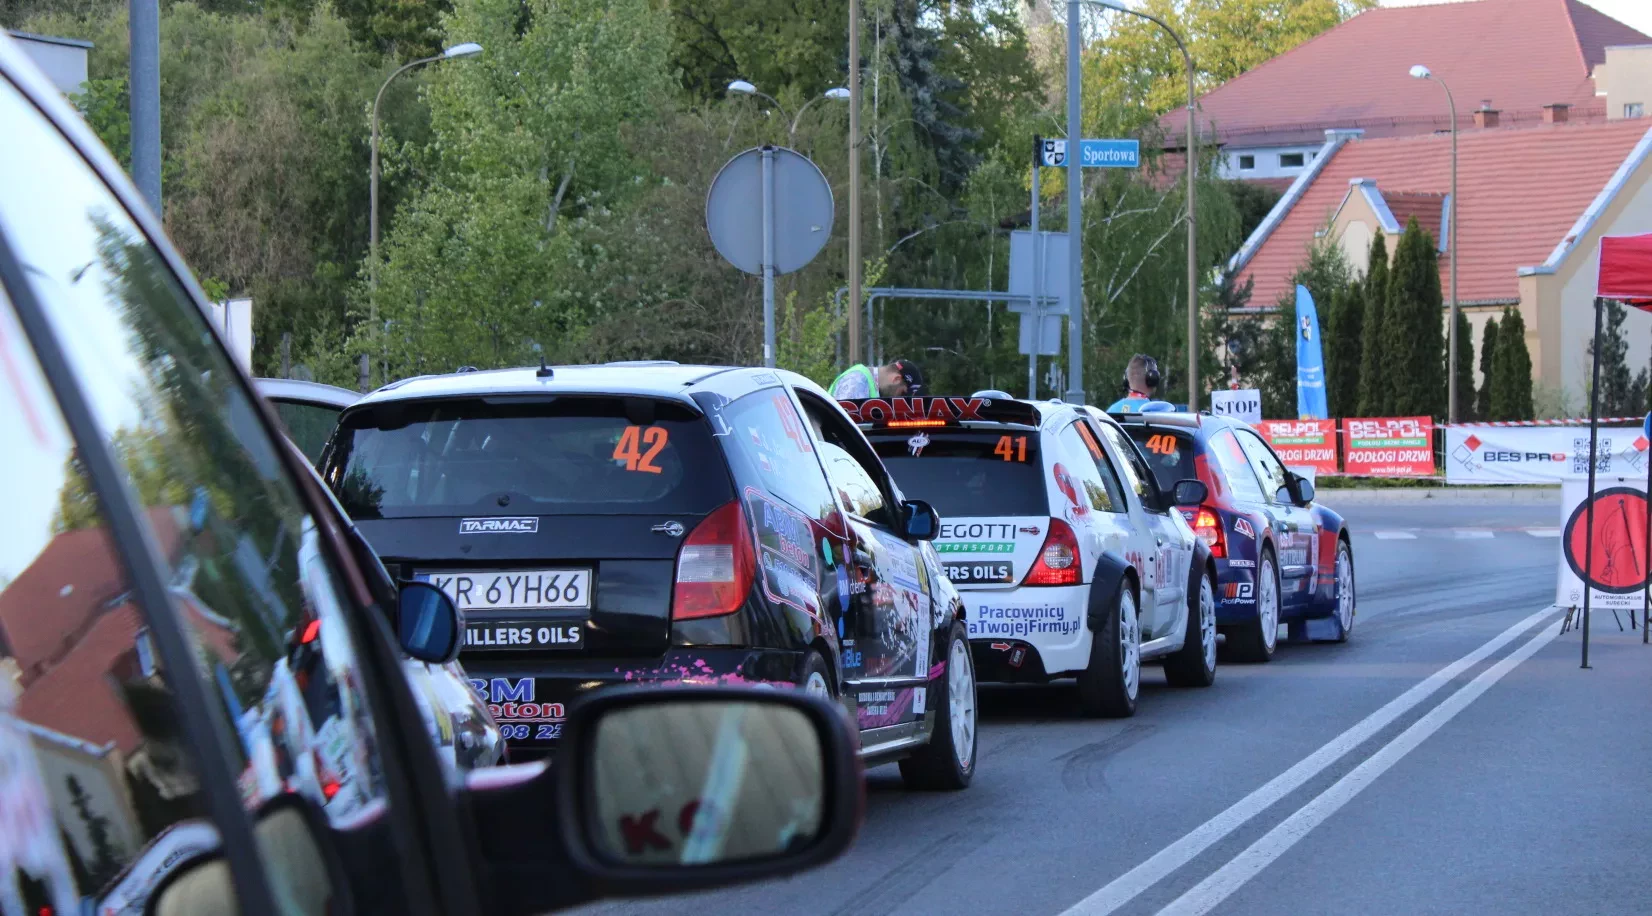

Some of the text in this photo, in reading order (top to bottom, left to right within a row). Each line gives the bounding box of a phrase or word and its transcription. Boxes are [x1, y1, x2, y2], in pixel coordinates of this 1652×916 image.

[1083, 145, 1136, 165] Sportowa
[1215, 400, 1258, 415] STOP
[612, 426, 668, 473] 42
[994, 435, 1027, 462] 41
[1145, 433, 1177, 455] 40
[1277, 448, 1334, 461] DŁOGI DRZWI
[1347, 449, 1431, 463] PODŁOGI DRZWI
[1483, 451, 1567, 462] BES PRO
[462, 519, 534, 532] TARMAC
[939, 524, 1017, 539] EGOTTI
[936, 543, 1013, 552] OTORSPORT
[973, 566, 1008, 580] OILS
[434, 573, 581, 605] KR 6YH66
[979, 603, 1065, 621] Pracownicy
[967, 616, 1081, 637] aTwojejFirmy.pl
[463, 626, 580, 646] ILLERS OILS
[468, 677, 536, 702] BM
[488, 702, 565, 718] eton
[499, 724, 531, 740] 08
